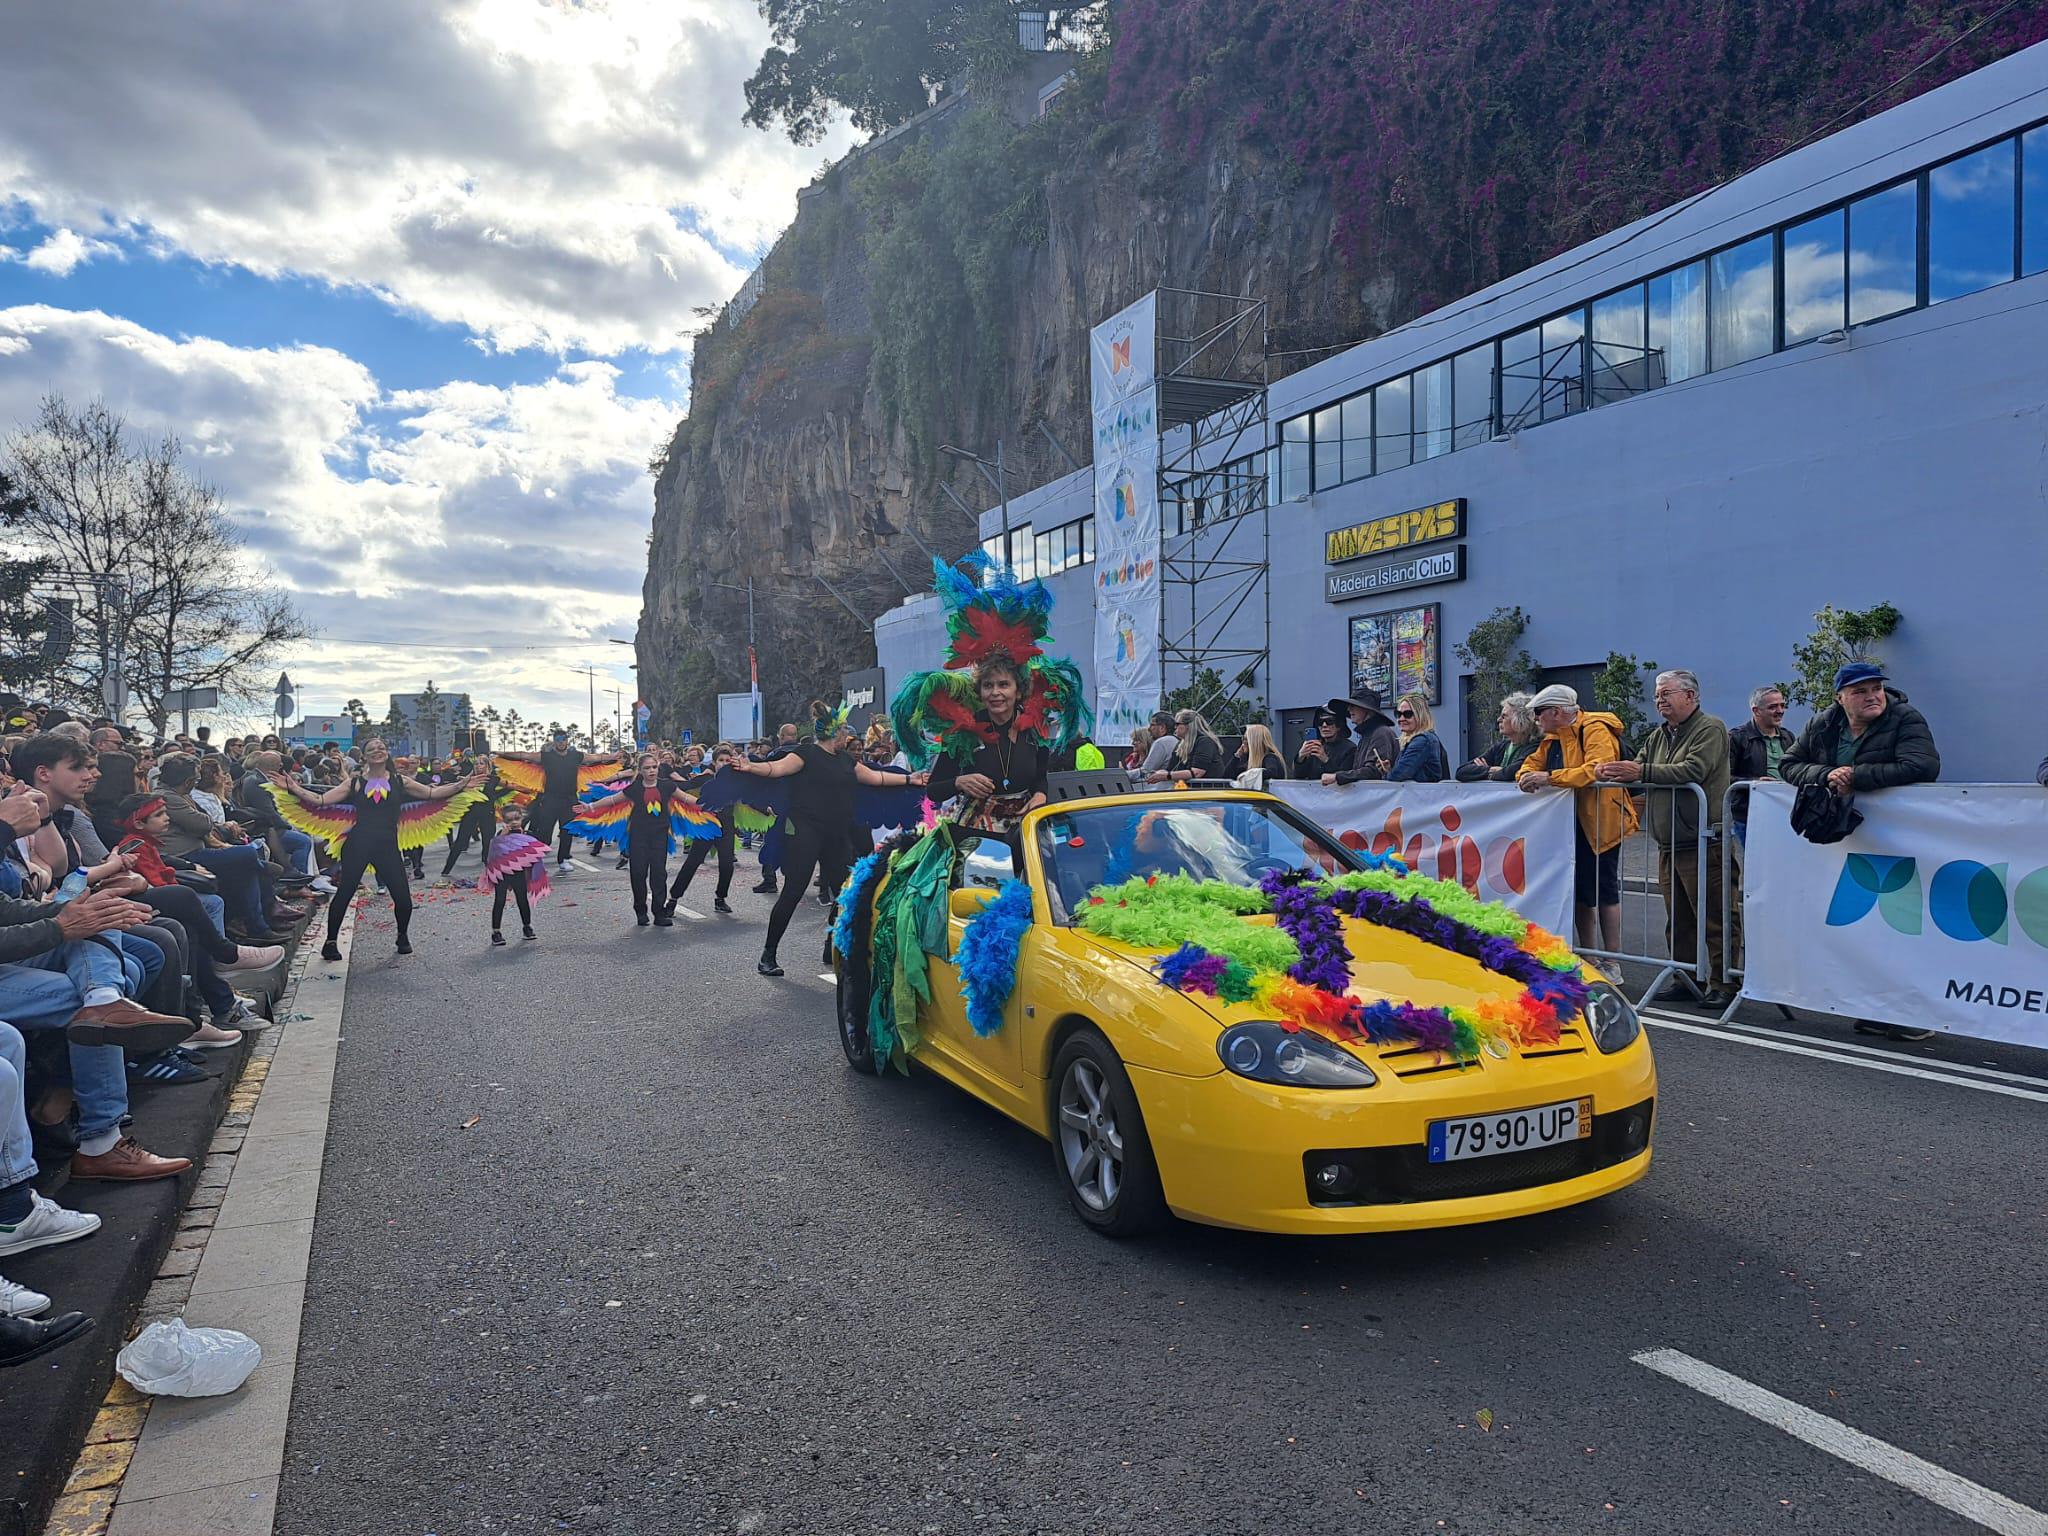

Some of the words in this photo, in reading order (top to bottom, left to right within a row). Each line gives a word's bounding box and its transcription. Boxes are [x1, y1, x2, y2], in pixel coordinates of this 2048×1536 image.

[1330, 572, 1376, 594] Madeira
[1378, 561, 1416, 585] Island
[1419, 556, 1452, 577] Club
[1945, 979, 2048, 1014] MADE
[1580, 1103, 1590, 1115] 03
[1580, 1122, 1590, 1134] 02
[1433, 1146, 1440, 1156] P
